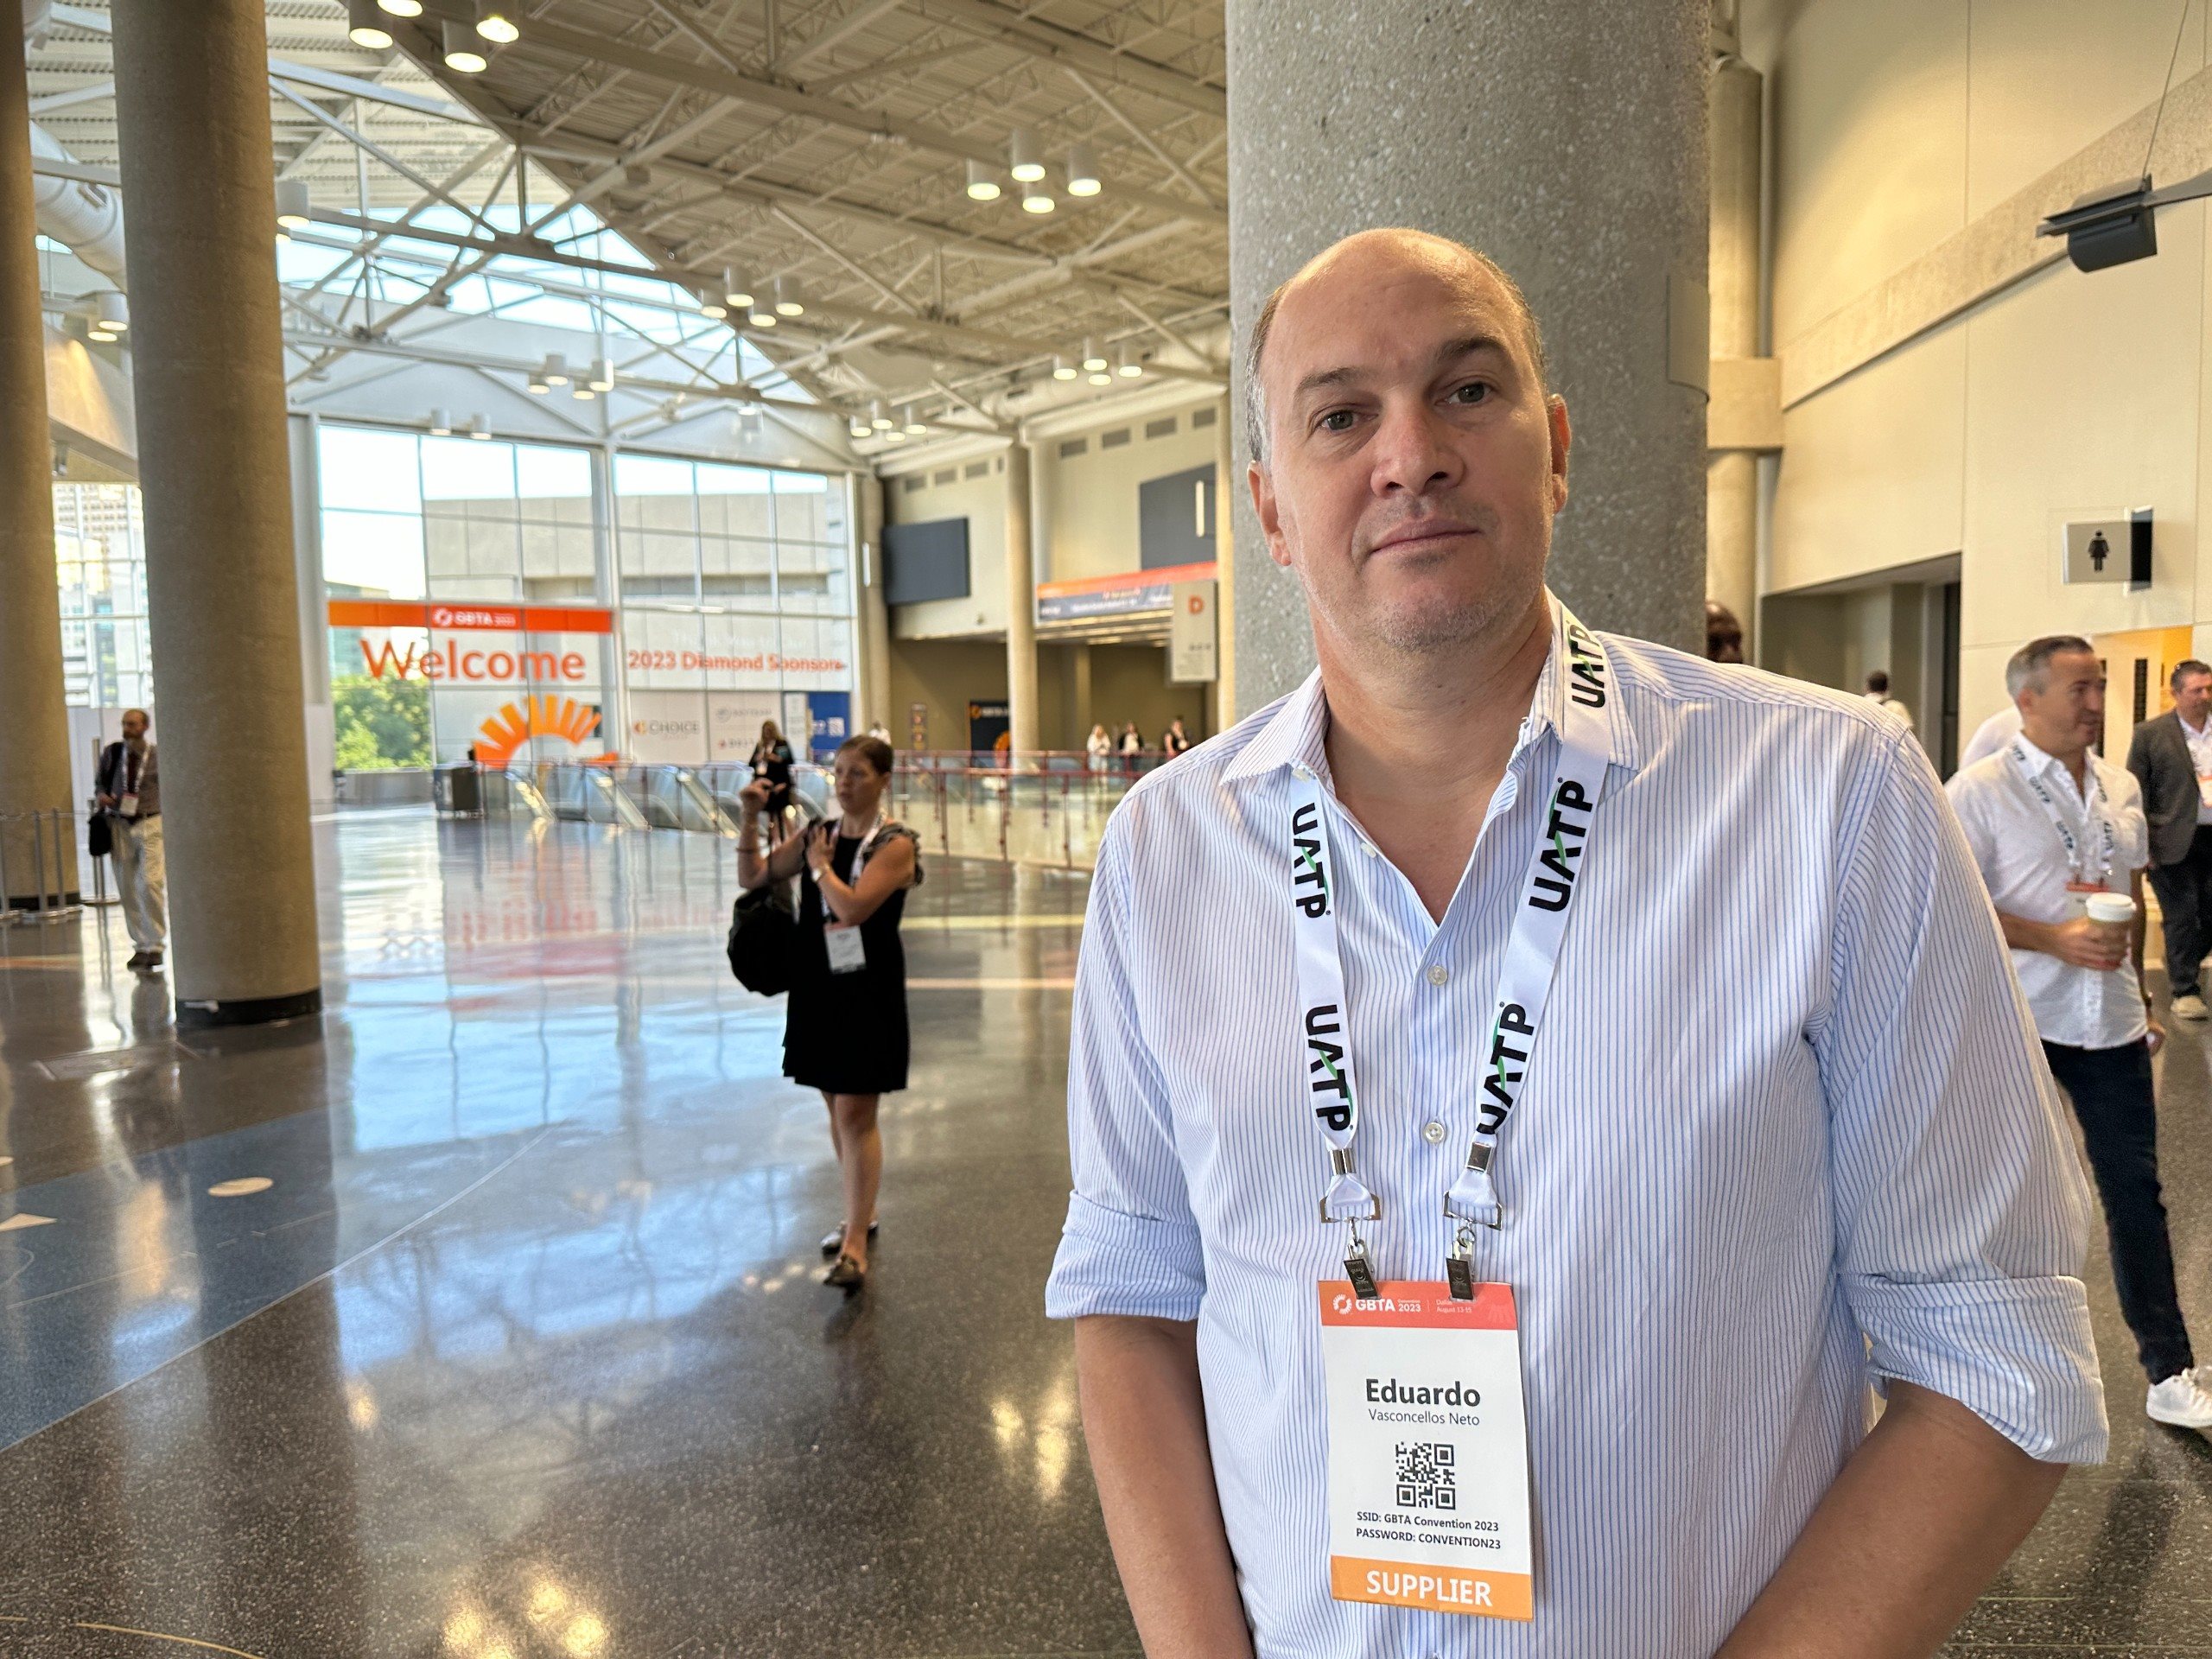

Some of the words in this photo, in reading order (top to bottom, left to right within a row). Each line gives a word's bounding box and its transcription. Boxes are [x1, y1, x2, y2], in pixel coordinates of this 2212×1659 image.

[1188, 595, 1204, 614] D
[359, 639, 586, 681] Welcome
[628, 651, 676, 670] 2023
[681, 652, 764, 671] Diamond
[767, 656, 844, 673] Sponsors
[1569, 623, 1606, 709] UATP
[649, 720, 700, 736] CHOICE
[1529, 776, 1595, 912] UATP
[1292, 801, 1327, 919] UATP
[1305, 1003, 1353, 1132] UATP
[1476, 1003, 1535, 1135] UATP
[1355, 1298, 1396, 1313] GBTA
[1398, 1304, 1421, 1313] 2023
[1366, 1378, 1481, 1408] Eduardo
[1368, 1408, 1446, 1425] Vasconcellos
[1449, 1412, 1480, 1426] Neto
[1357, 1511, 1382, 1523] SSID:
[1384, 1514, 1412, 1526] GBTA
[1414, 1516, 1471, 1529] Convention
[1474, 1521, 1499, 1532] 2023
[1356, 1528, 1416, 1542] PASSWORD:
[1418, 1533, 1501, 1550] CONVENTION23
[1366, 1569, 1494, 1607] SUPPLIER
